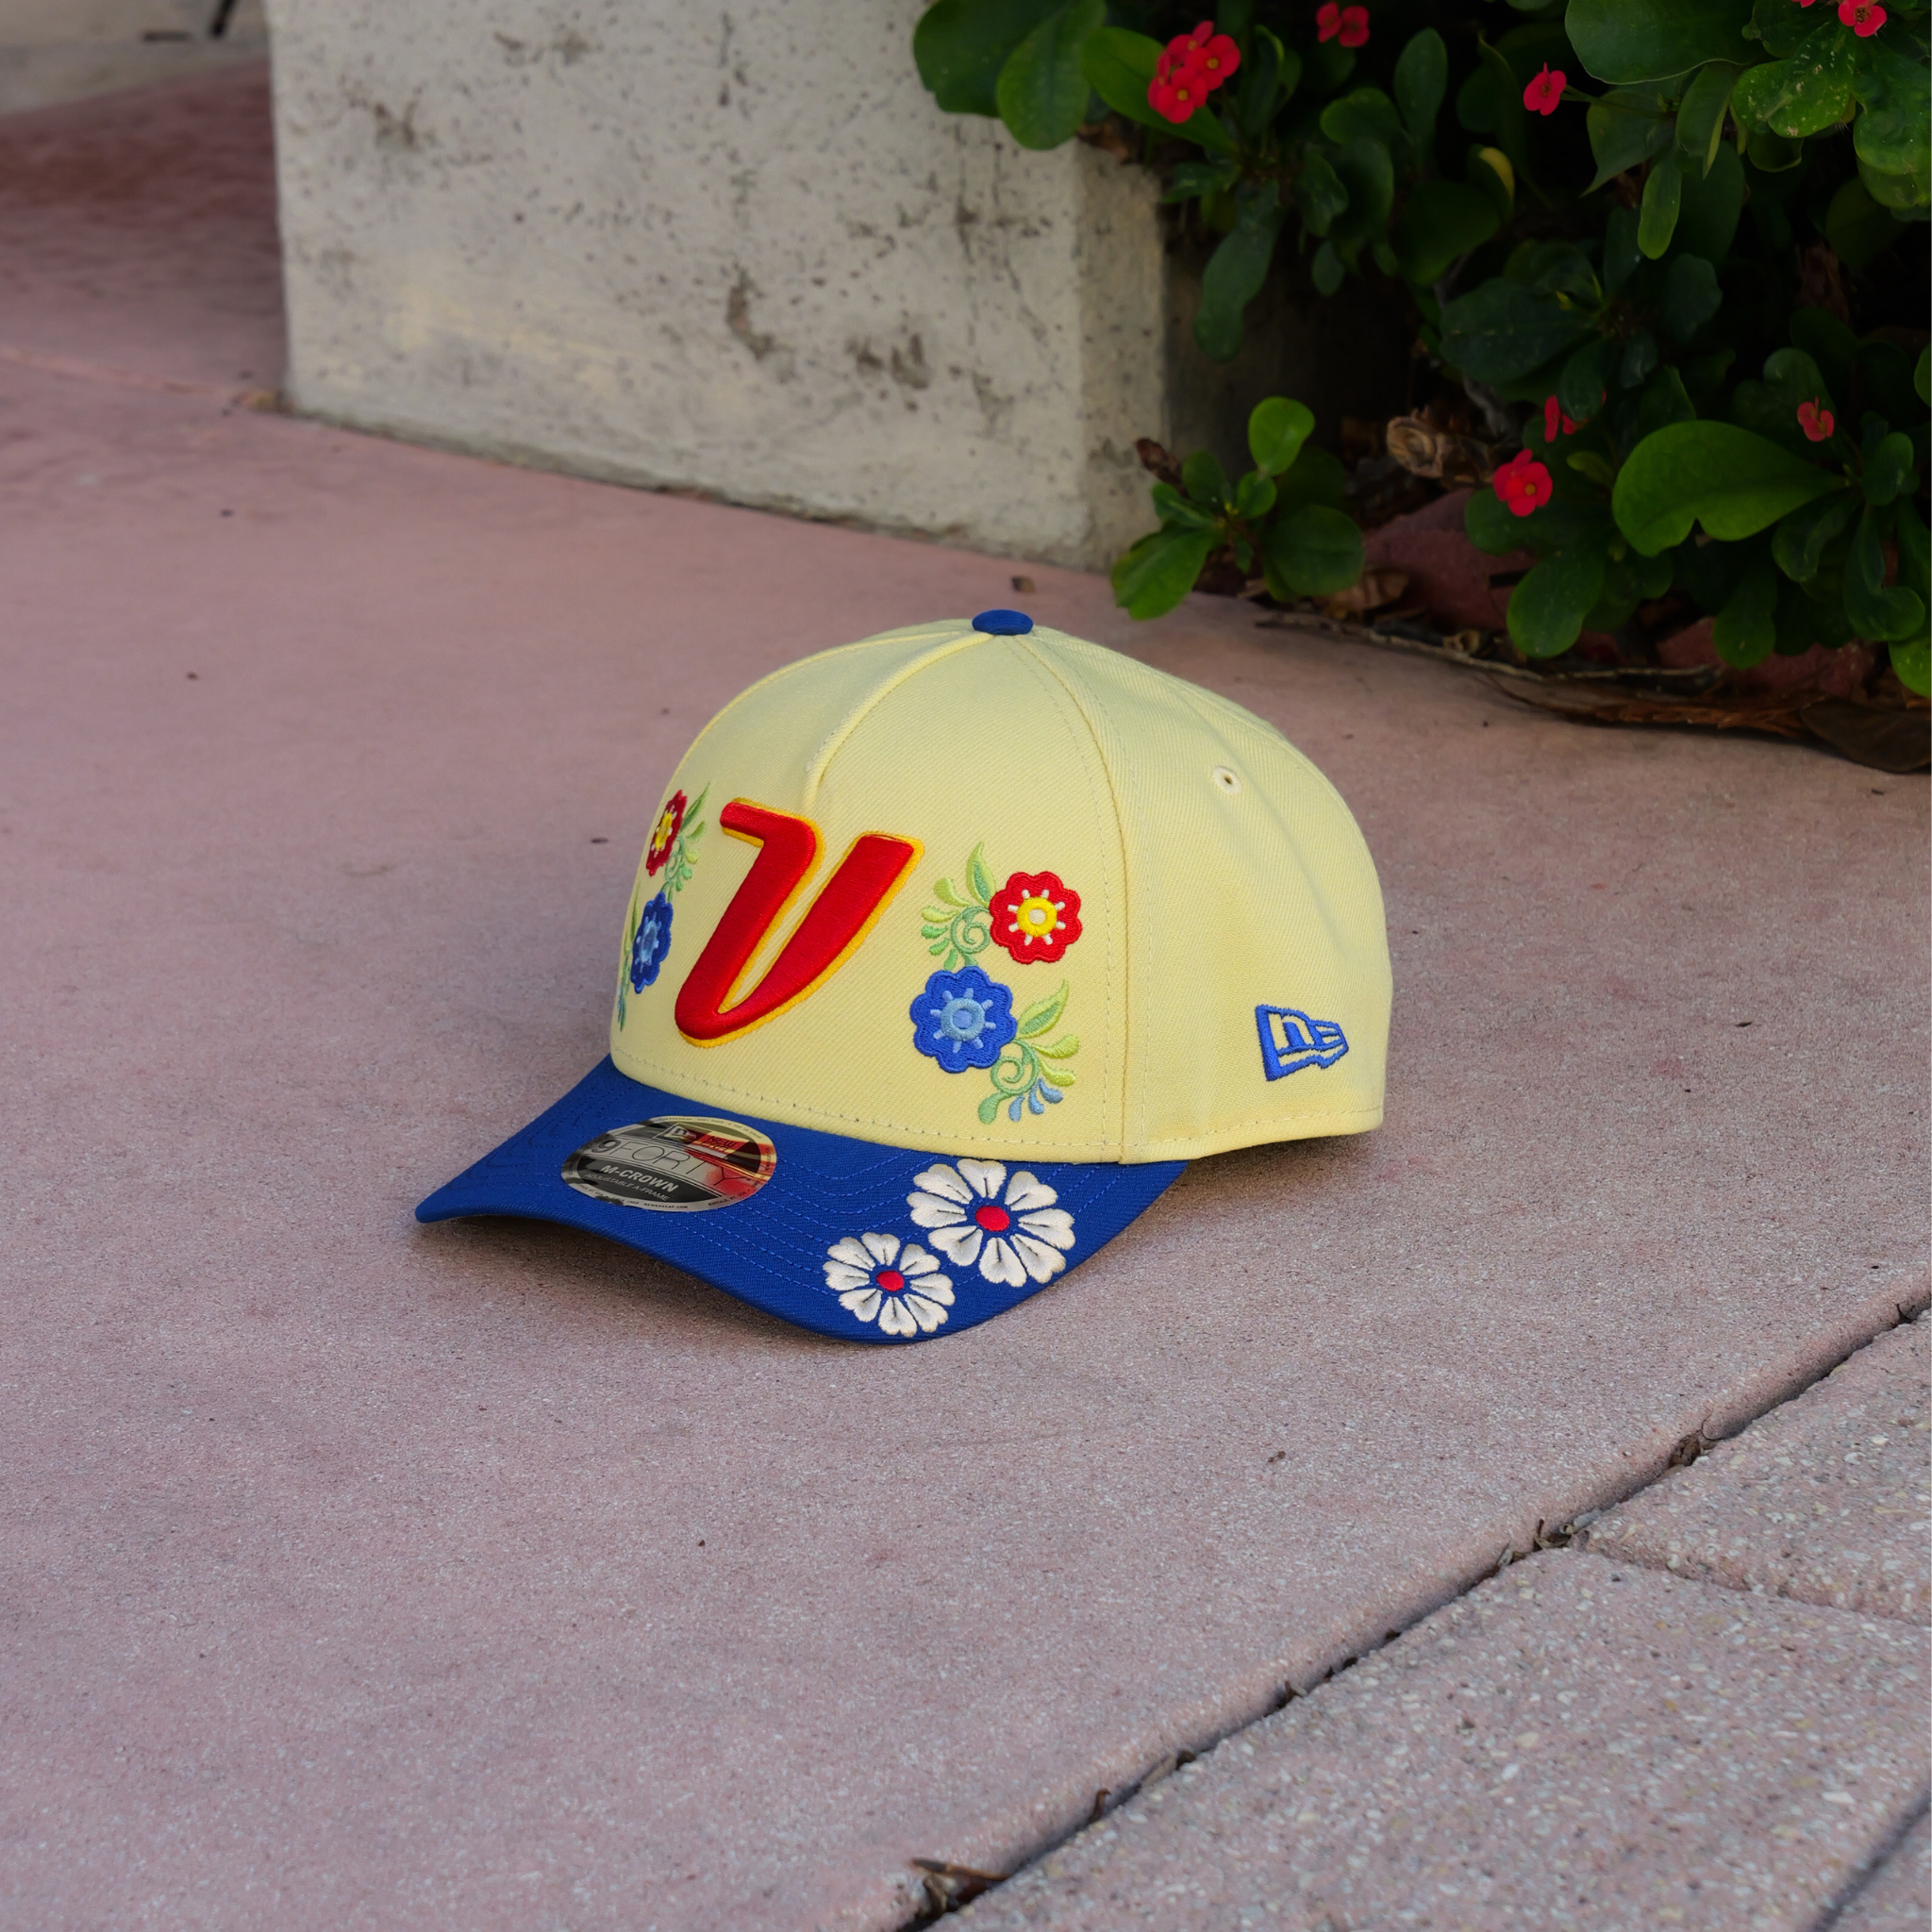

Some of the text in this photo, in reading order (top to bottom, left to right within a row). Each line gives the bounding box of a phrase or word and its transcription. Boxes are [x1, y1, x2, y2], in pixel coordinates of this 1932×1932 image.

[675, 797, 924, 1048] V
[708, 1136, 738, 1148] NEW
[591, 1139, 747, 1187] 9FORTY
[584, 1174, 635, 1188] ADJUSTABLE
[632, 1185, 671, 1202] A-FRAME
[599, 1165, 678, 1192] M-CROWN
